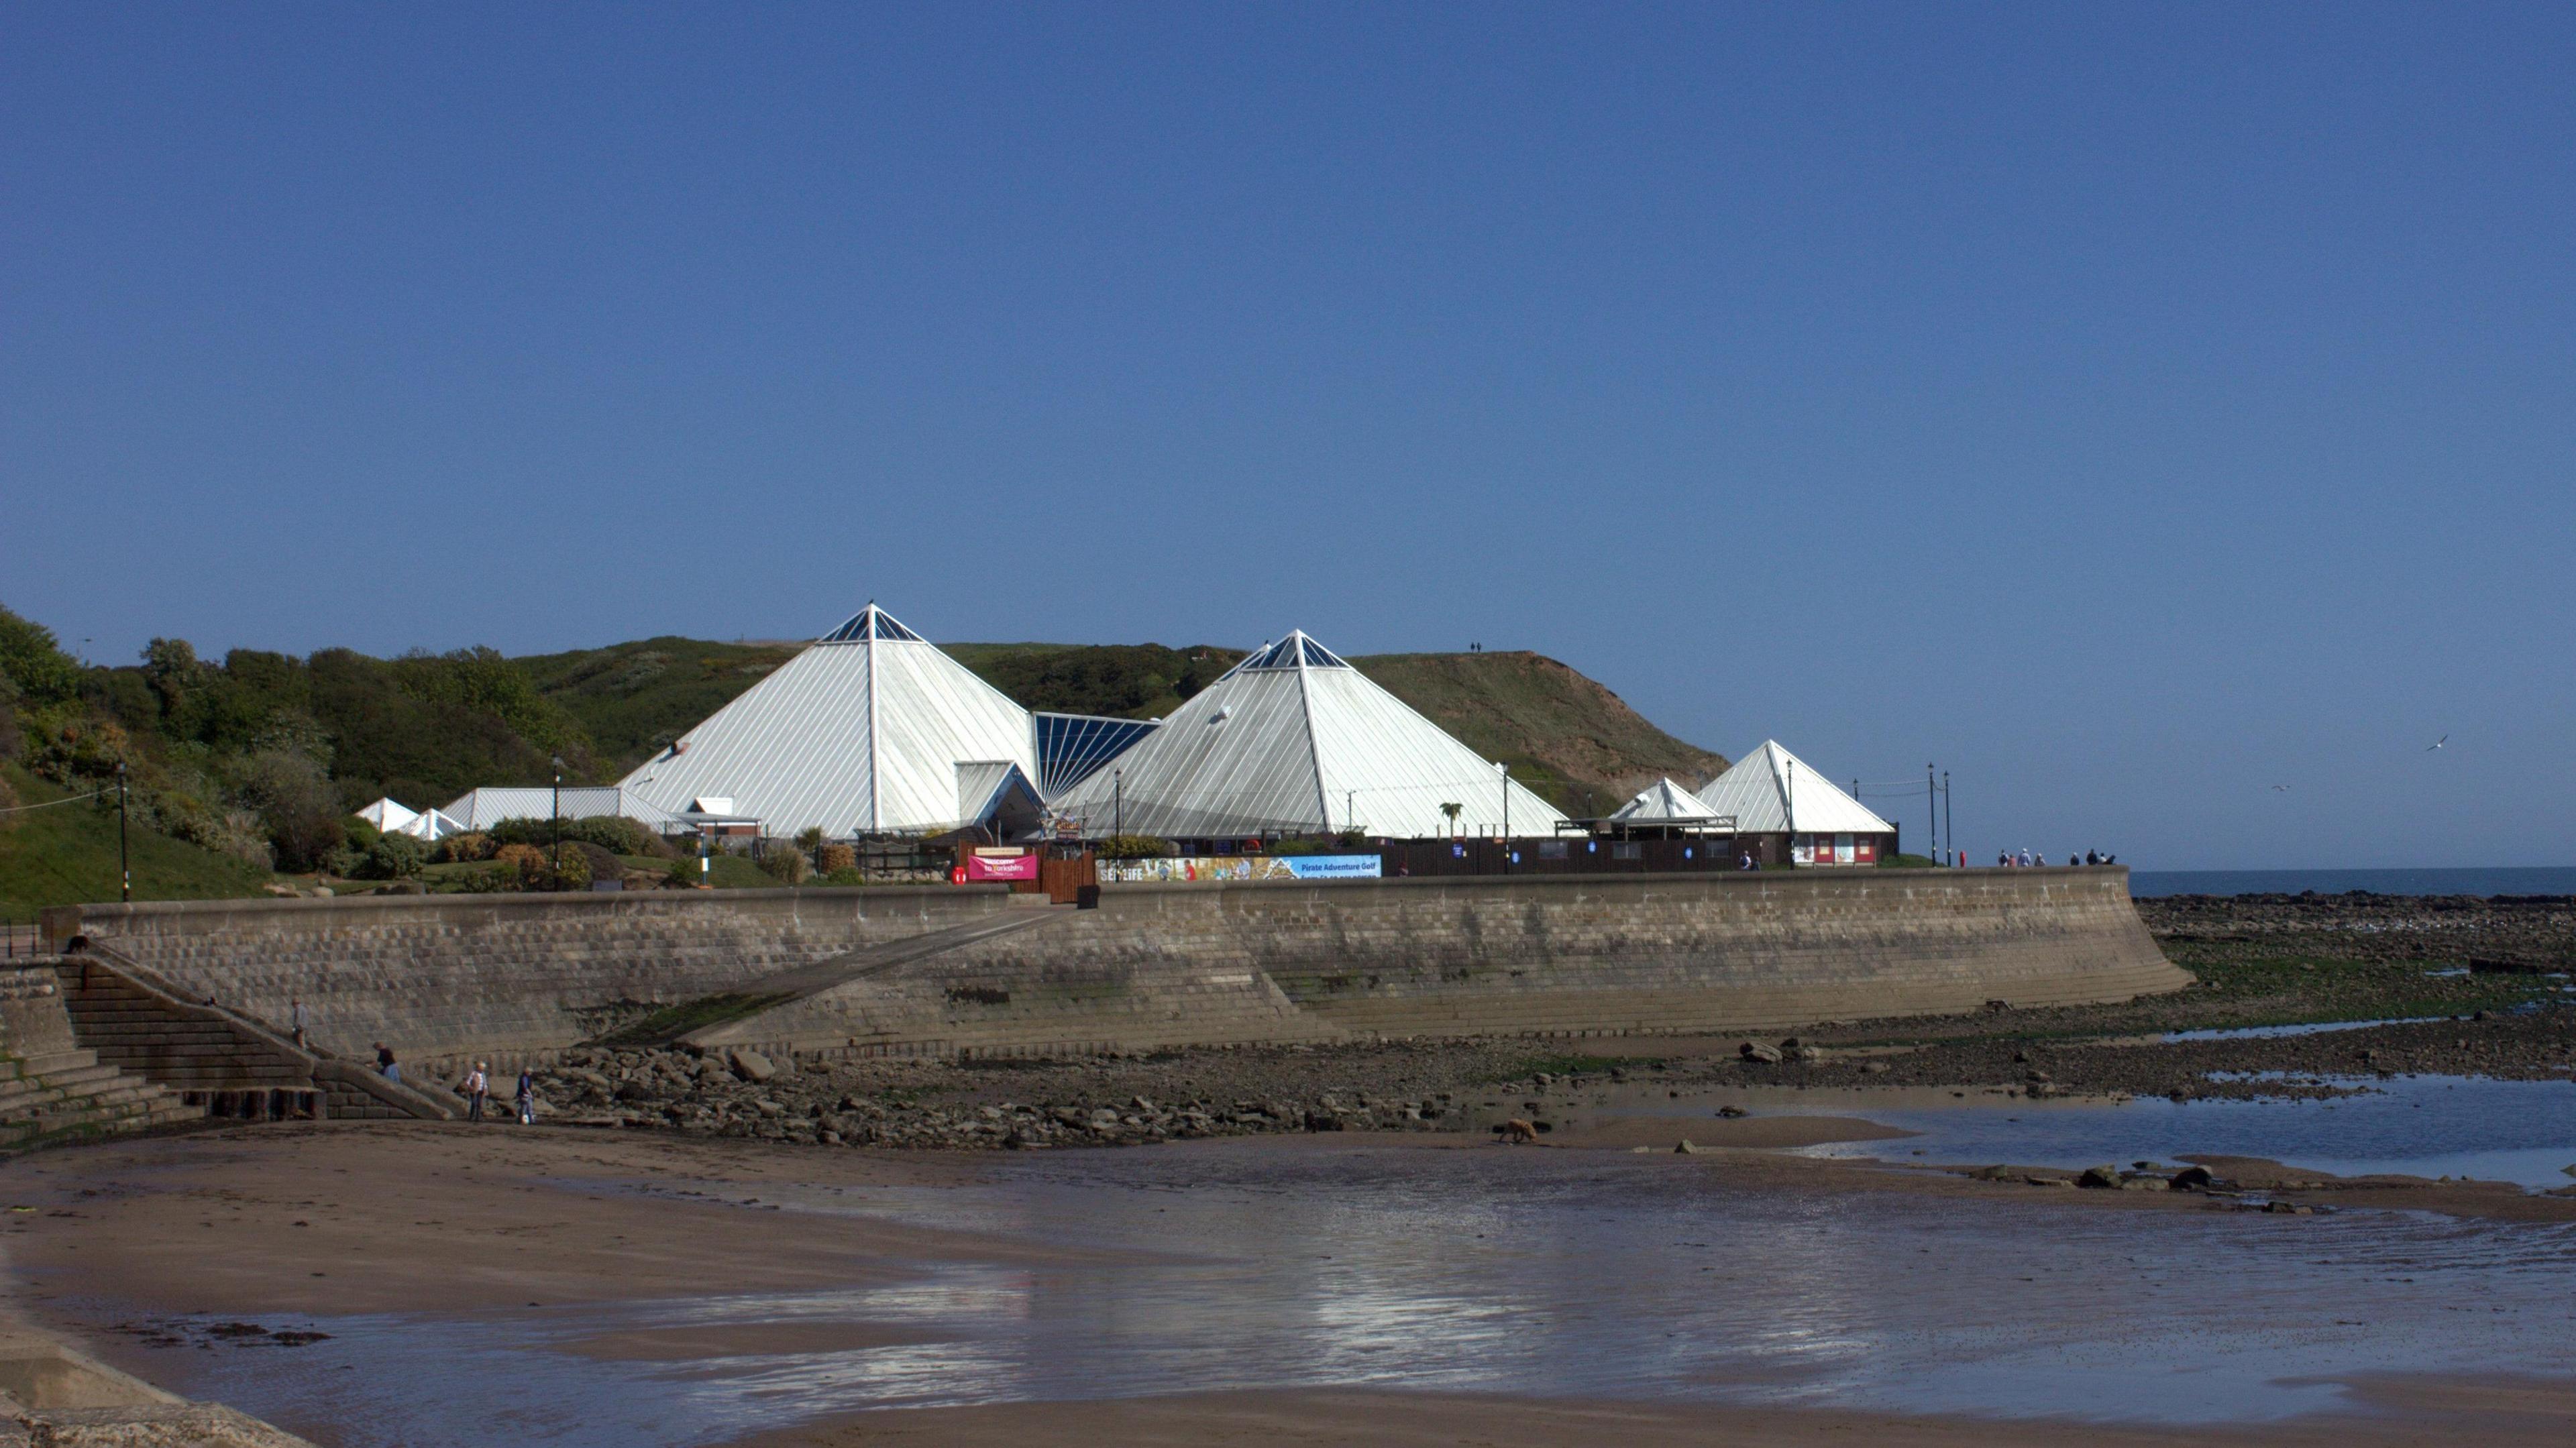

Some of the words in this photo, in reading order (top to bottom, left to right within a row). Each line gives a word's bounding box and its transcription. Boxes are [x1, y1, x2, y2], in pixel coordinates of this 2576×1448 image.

[992, 864, 1024, 872] Yorkshire
[1301, 863, 1322, 871] Pirate
[1324, 862, 1360, 871] Adventure
[1361, 862, 1376, 870] Golf
